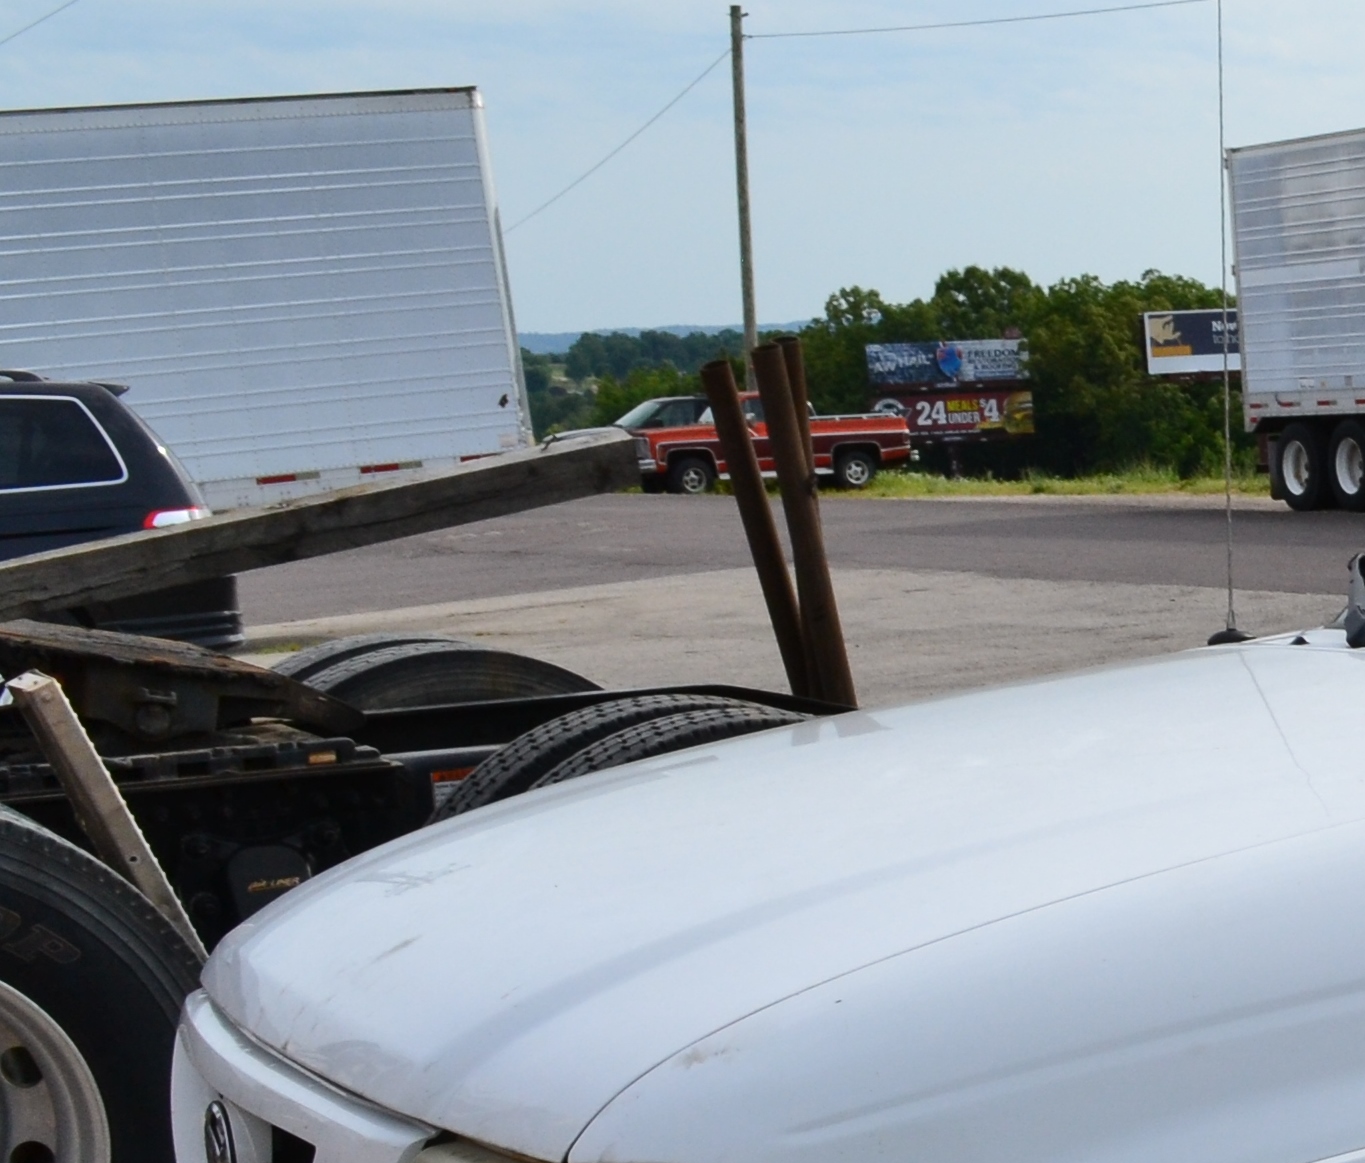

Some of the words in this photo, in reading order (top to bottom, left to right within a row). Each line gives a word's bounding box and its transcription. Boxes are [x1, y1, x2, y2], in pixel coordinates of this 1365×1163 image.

[915, 400, 947, 426] 24
[946, 399, 979, 412] MEALS
[980, 398, 1001, 422] $4
[948, 411, 981, 424] UNDER
